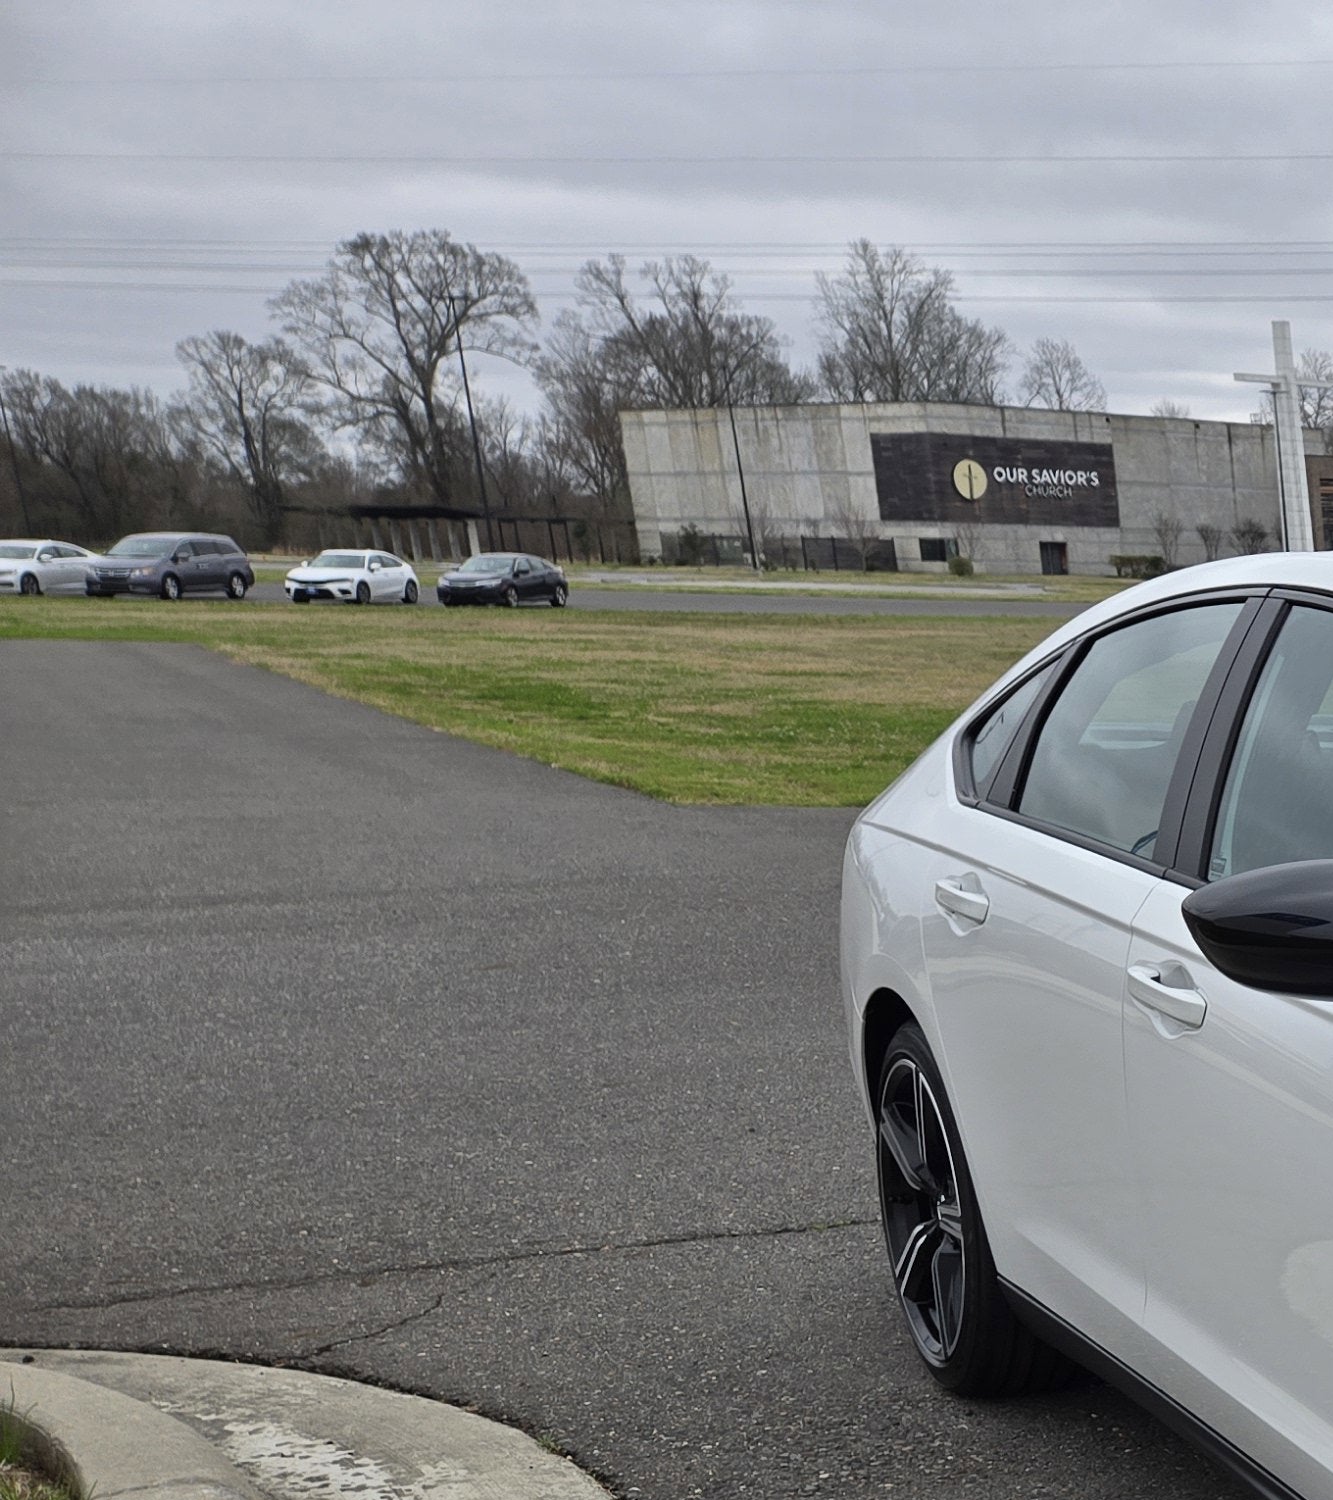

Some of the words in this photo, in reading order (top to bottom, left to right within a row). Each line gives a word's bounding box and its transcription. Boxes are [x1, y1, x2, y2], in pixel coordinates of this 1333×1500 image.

[993, 467, 1029, 484] OUR
[1032, 469, 1099, 486] SAVIOR'S
[1025, 484, 1073, 498] CHURCH
